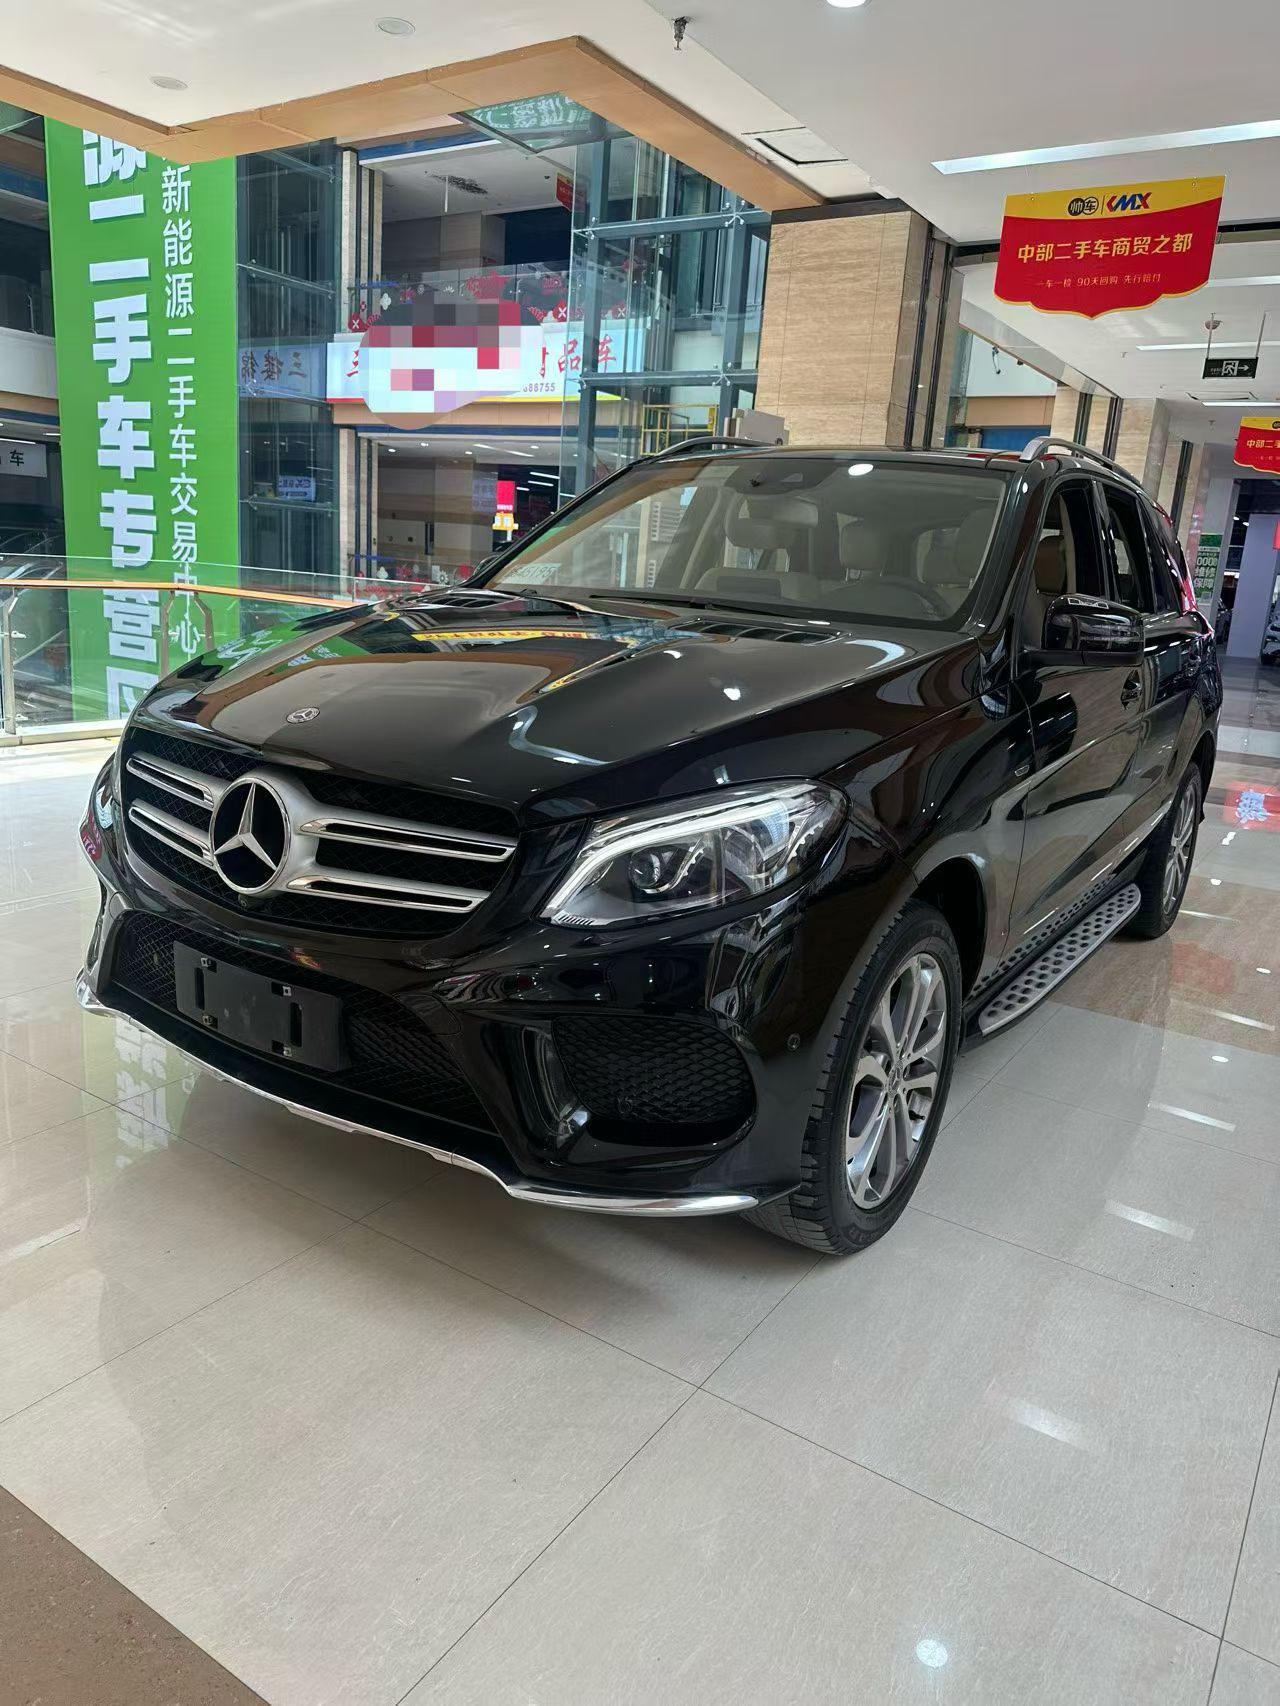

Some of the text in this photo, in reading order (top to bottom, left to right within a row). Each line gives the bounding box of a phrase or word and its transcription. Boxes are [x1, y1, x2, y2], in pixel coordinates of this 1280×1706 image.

[1017, 233, 1193, 263] 中部二手车商贸之都
[1077, 275, 1119, 287] 90天回购
[160, 165, 200, 656] 新能源二手车交易中心
